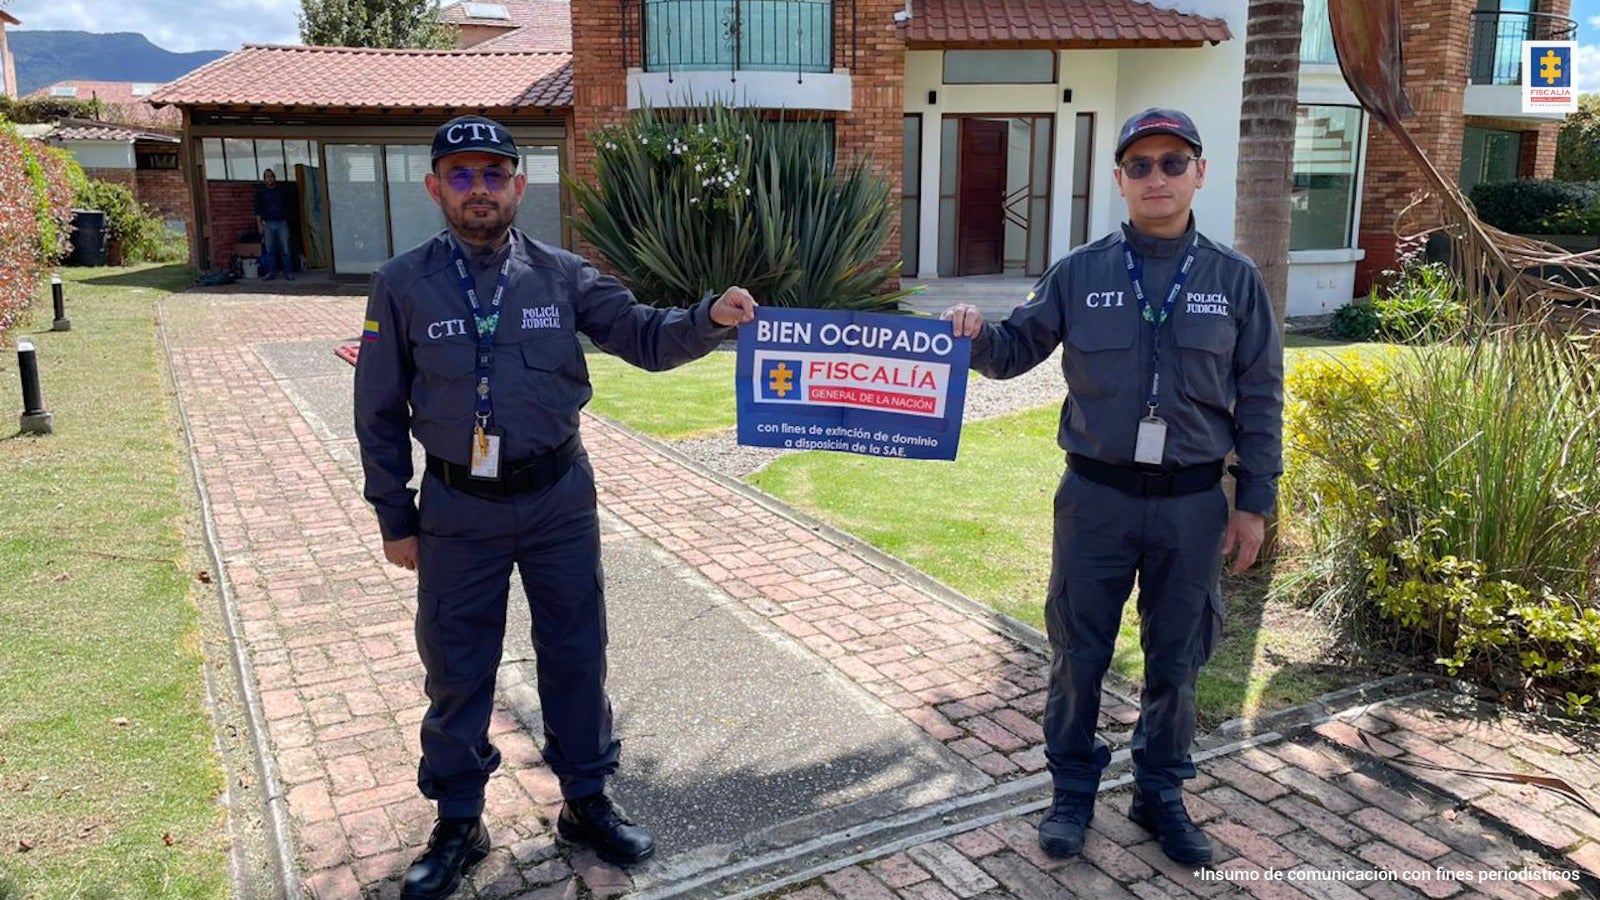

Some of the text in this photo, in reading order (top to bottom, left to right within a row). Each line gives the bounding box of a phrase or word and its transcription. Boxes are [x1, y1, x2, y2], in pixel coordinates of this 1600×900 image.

[446, 122, 501, 144] CTI
[1086, 291, 1125, 308] CTI
[1186, 292, 1229, 305] POLICÍA
[522, 304, 560, 319] POLICÍA
[1186, 303, 1229, 316] JUDICIAL
[427, 319, 467, 340] CTI
[521, 317, 561, 329] JUDICIAL
[757, 320, 953, 355] BIEN OCUPADO
[809, 361, 937, 390] FISCALÍA
[811, 388, 933, 410] GENERAL DE LA NACIÓN
[757, 424, 779, 433] con
[781, 422, 806, 434] fines
[808, 424, 823, 435] de
[873, 430, 889, 442] de
[891, 433, 939, 448] dominio
[784, 438, 907, 457] a disposición de la SAE.
